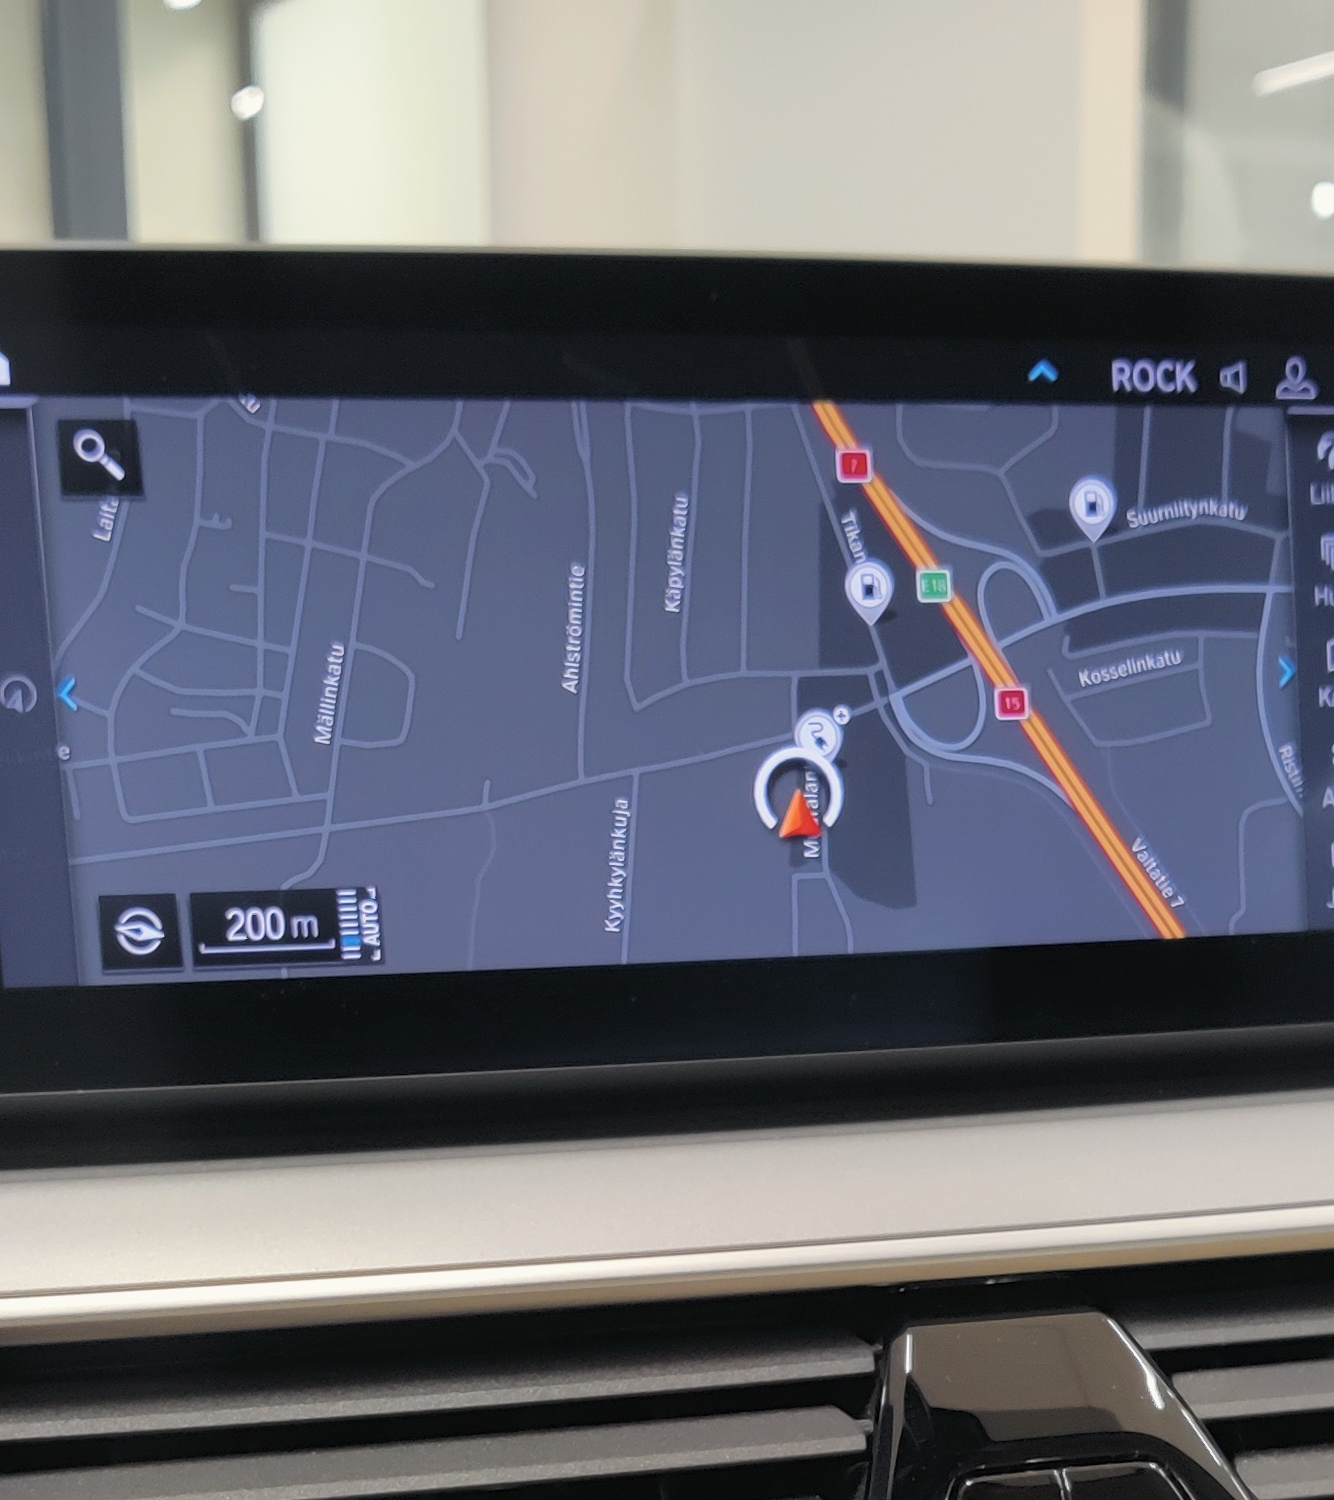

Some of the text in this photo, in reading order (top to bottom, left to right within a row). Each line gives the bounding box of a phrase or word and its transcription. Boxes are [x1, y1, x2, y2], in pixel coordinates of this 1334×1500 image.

[1111, 357, 1198, 394] ROCK
[664, 494, 689, 613] Käpylänkatu
[561, 562, 586, 694] Ahlströmintie
[314, 641, 345, 746] Mällinkatu
[1077, 650, 1184, 688] Kosselinkatu
[604, 798, 630, 933] Kyyhkylänkuja
[1131, 834, 1186, 909] Valtatie 7
[224, 905, 320, 942] 200 m
[358, 898, 381, 947] AUTO
